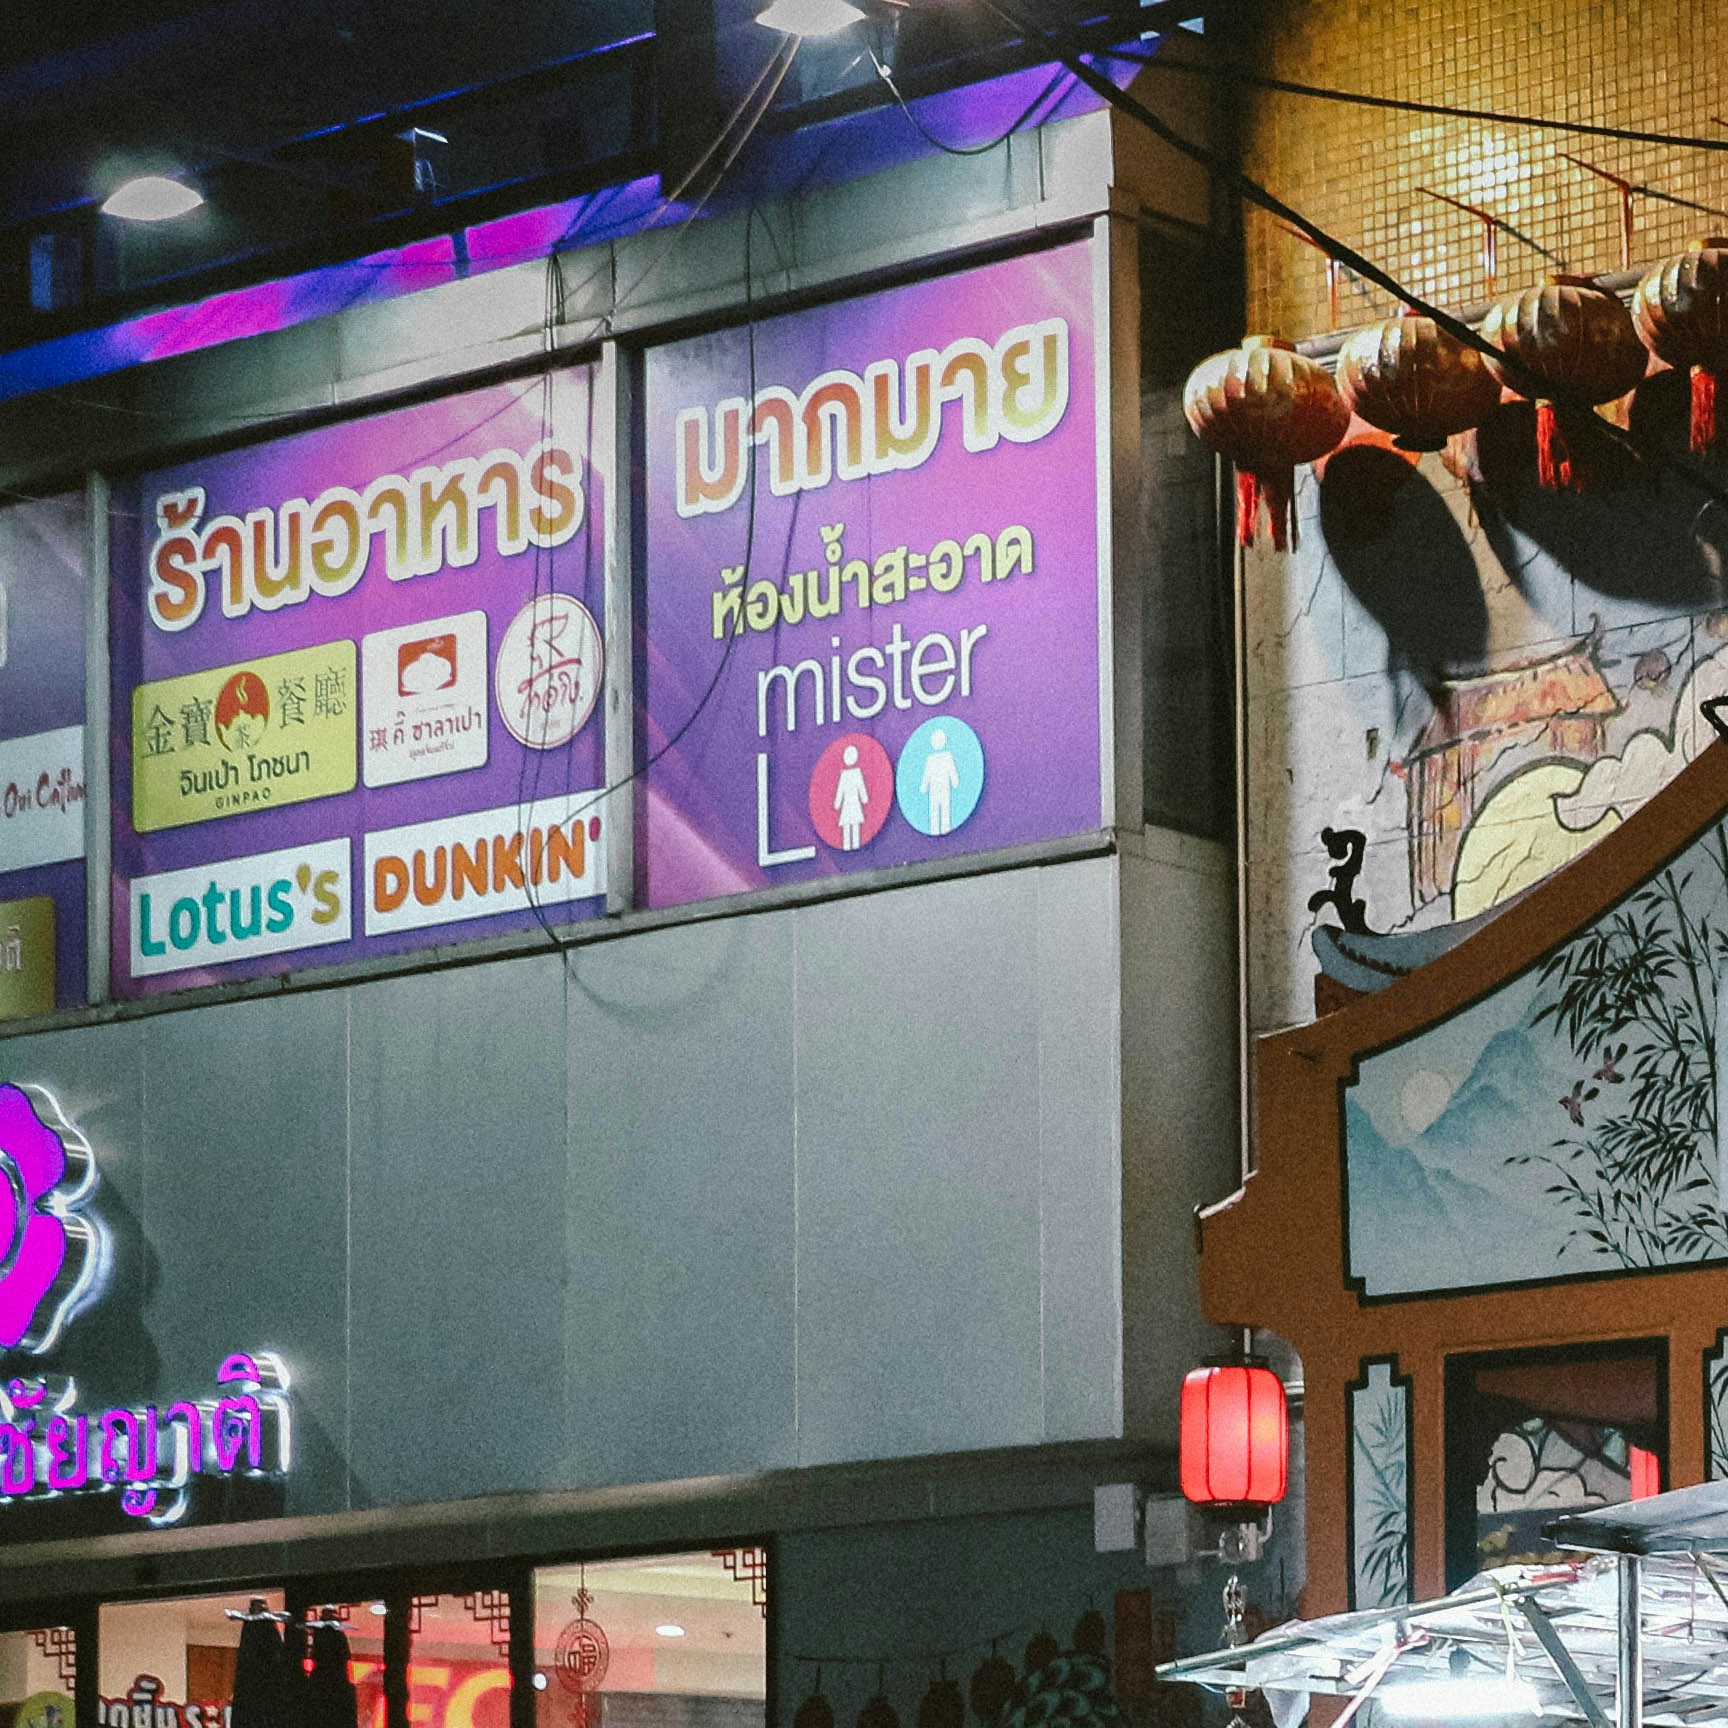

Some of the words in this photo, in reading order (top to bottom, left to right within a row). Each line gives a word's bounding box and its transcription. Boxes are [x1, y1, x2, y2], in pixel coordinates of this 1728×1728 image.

[676, 317, 1070, 518] มากมาย
[149, 440, 587, 632] ร้านอาหาร
[711, 523, 1034, 641] ห้องน้ำสะอาด
[142, 696, 214, 760] 金寶
[277, 665, 347, 731] 餐廳
[757, 622, 989, 738] mister
[215, 787, 272, 810] GINPAO
[248, 750, 310, 783] โภชนา
[139, 863, 341, 957] Lotus's
[373, 816, 601, 914] DUNKIN'
